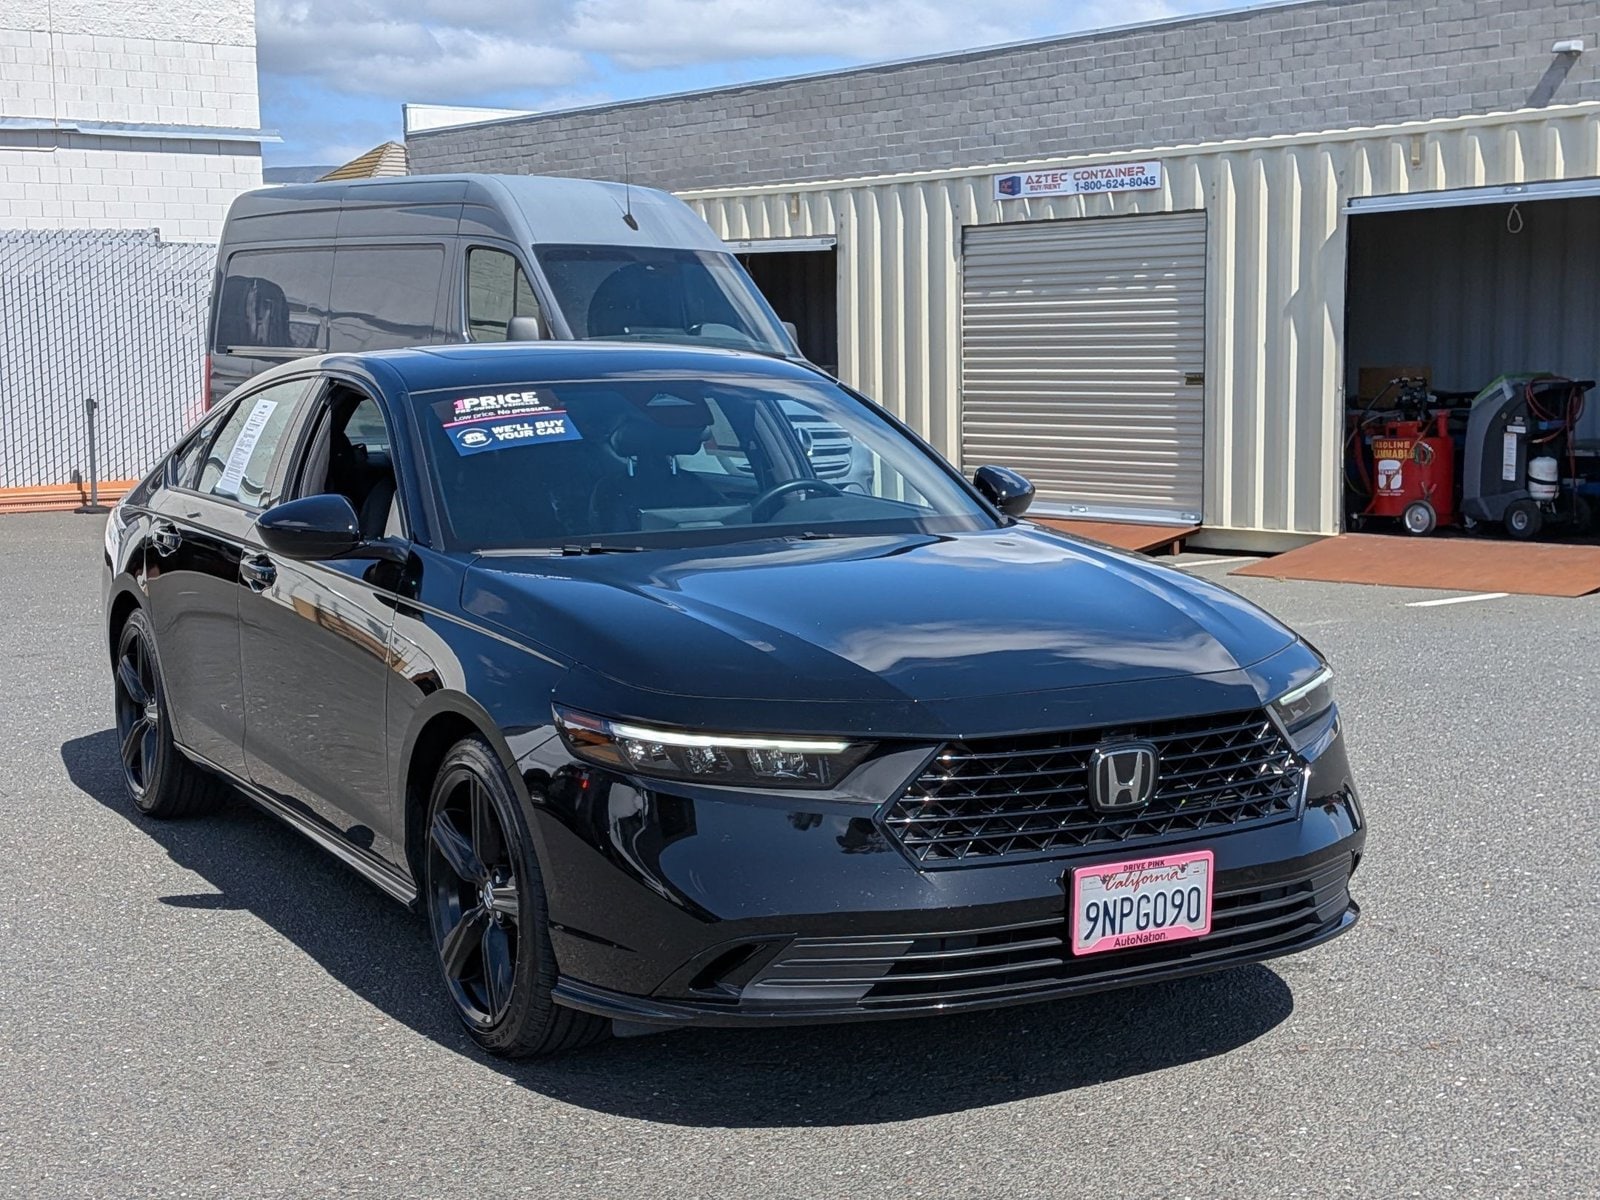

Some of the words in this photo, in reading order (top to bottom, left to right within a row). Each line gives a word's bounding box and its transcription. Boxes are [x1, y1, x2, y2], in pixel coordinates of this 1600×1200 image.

[1025, 173, 1068, 184] AZTEC
[1073, 166, 1146, 180] CONTAINER
[1075, 176, 1156, 191] 1-800-624-8045
[491, 423, 534, 434] WE'LL
[535, 419, 564, 428] BUY
[495, 429, 535, 440] YOUR
[536, 426, 566, 435] CAR
[1123, 861, 1146, 871] DRIVE
[1147, 860, 1165, 869] PINK
[1105, 870, 1187, 892] California
[1083, 886, 1201, 941] 9NPG090
